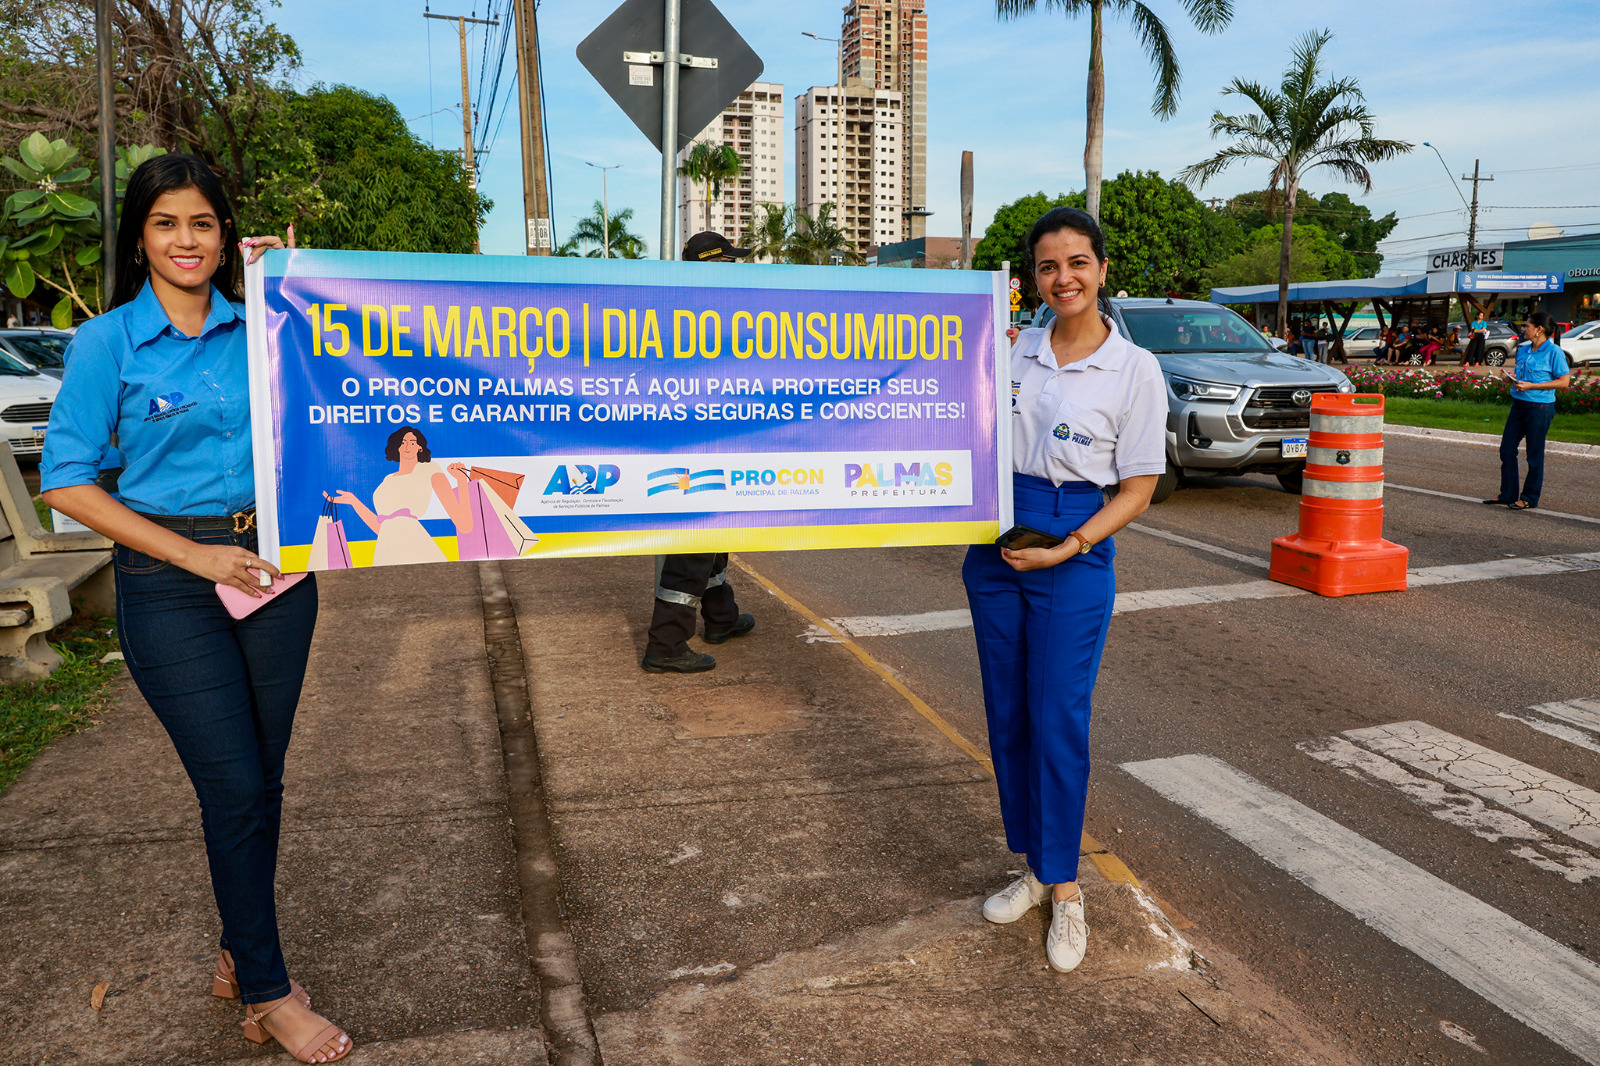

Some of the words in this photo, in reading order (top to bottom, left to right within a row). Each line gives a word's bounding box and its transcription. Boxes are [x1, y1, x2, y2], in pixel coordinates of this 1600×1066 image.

[307, 304, 349, 356] 15
[362, 305, 412, 356] DE
[424, 306, 569, 373] MARÇO
[603, 309, 663, 358] DIA
[674, 310, 721, 358] DO
[732, 311, 962, 360] CONSUMIDOR
[342, 378, 359, 395] O
[369, 378, 469, 395] PROCON
[479, 378, 573, 395] PALMAS
[582, 373, 638, 395] ESTÁ
[649, 378, 699, 399] AQUI
[708, 378, 764, 395] PARA
[773, 378, 880, 395] PROTEGER
[888, 378, 938, 395] SEUS
[309, 406, 420, 422] DIREITOS
[430, 405, 442, 422] E
[452, 405, 570, 421] GARANTIR
[579, 404, 687, 421] COMPRAS
[695, 404, 793, 420] SEGURAS
[802, 403, 812, 419] E
[820, 403, 965, 419] CONSCIENTES!
[730, 469, 824, 486] PROCON
[844, 462, 953, 488] PALMAS
